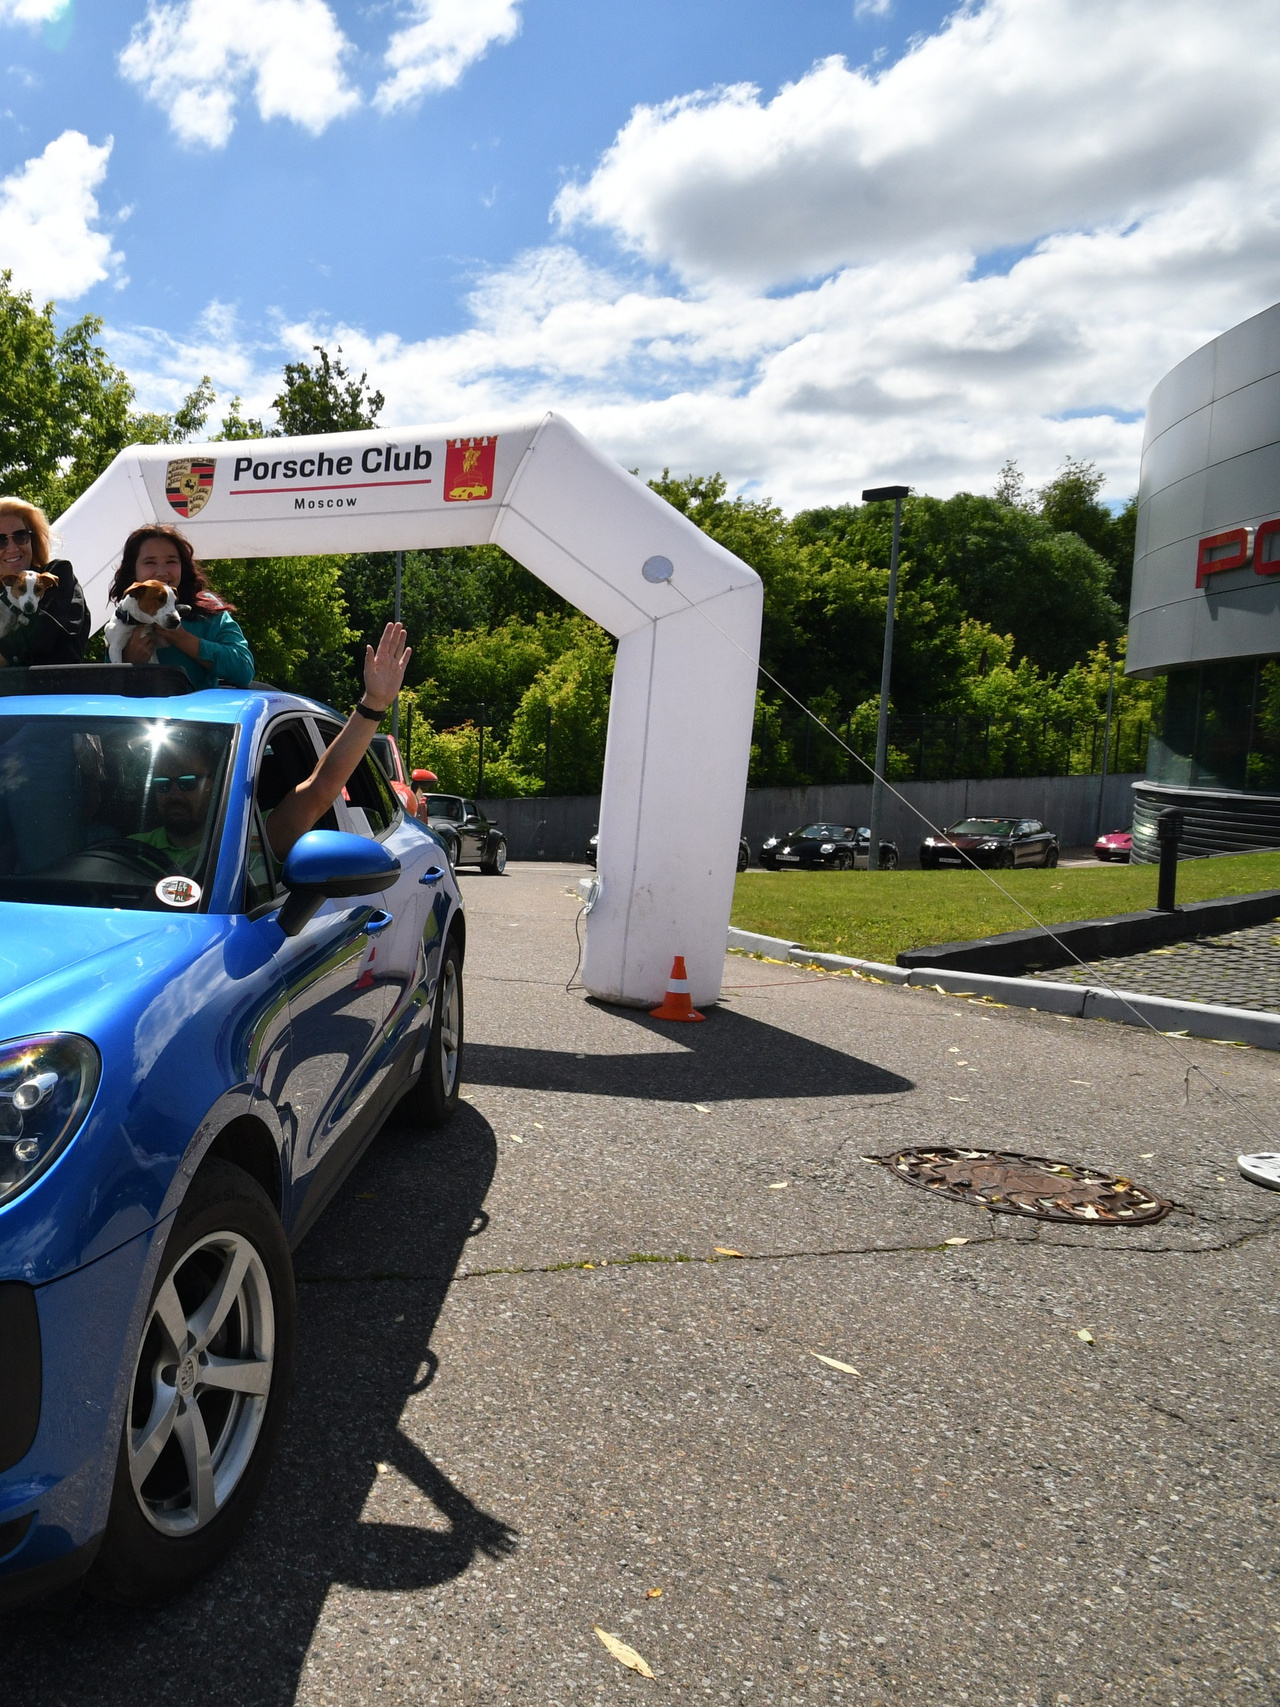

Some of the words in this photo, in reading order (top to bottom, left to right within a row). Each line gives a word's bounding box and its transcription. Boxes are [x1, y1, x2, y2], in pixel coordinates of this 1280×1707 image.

[233, 452, 352, 482] Porsche
[361, 444, 432, 473] Club
[294, 497, 357, 510] Moscow
